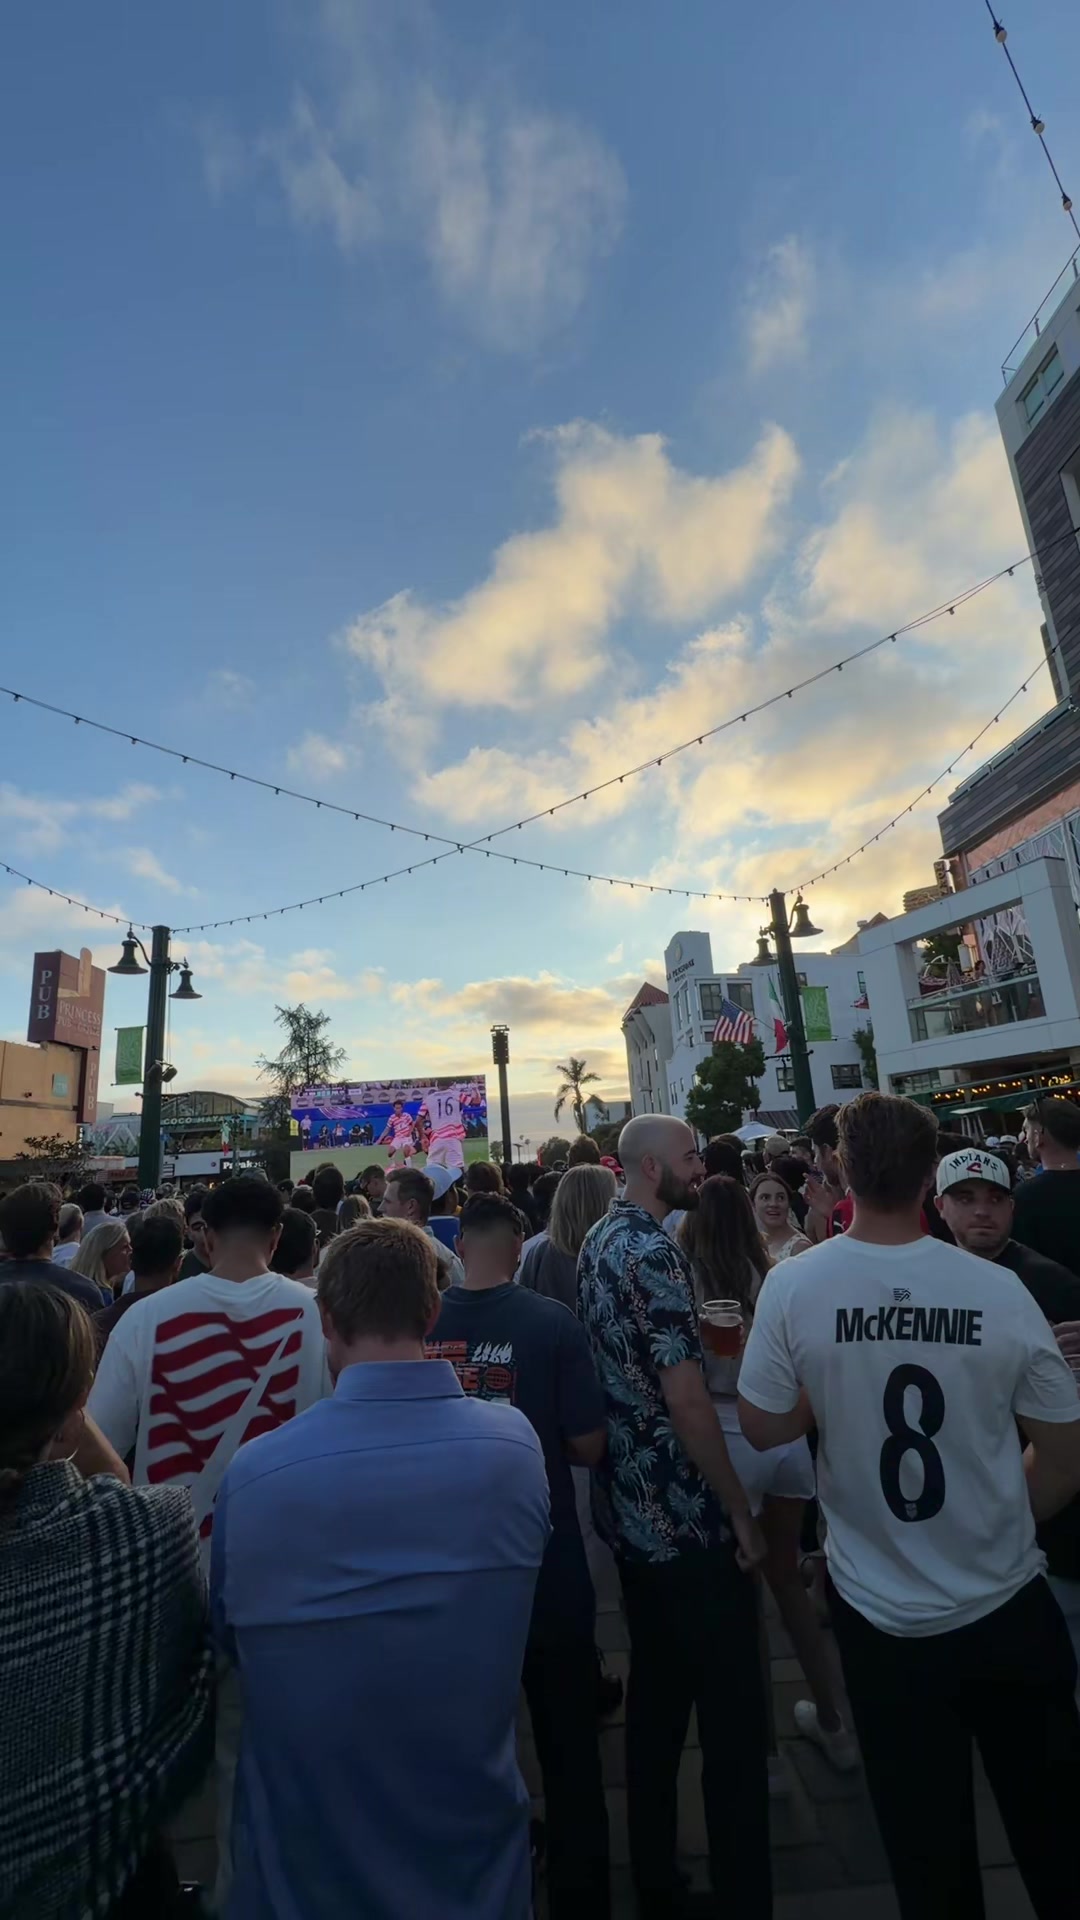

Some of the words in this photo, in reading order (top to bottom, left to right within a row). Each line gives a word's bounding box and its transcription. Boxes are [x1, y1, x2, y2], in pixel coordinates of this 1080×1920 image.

[37, 969, 53, 1020] PUB
[59, 999, 101, 1025] PRINCESS
[87, 1063, 98, 1111] PUB
[163, 1117, 192, 1125] COCO
[437, 1096, 454, 1119] 16
[949, 1154, 998, 1171] INDIANS
[835, 1306, 983, 1347] McKENNIE
[879, 1363, 946, 1523] 8
